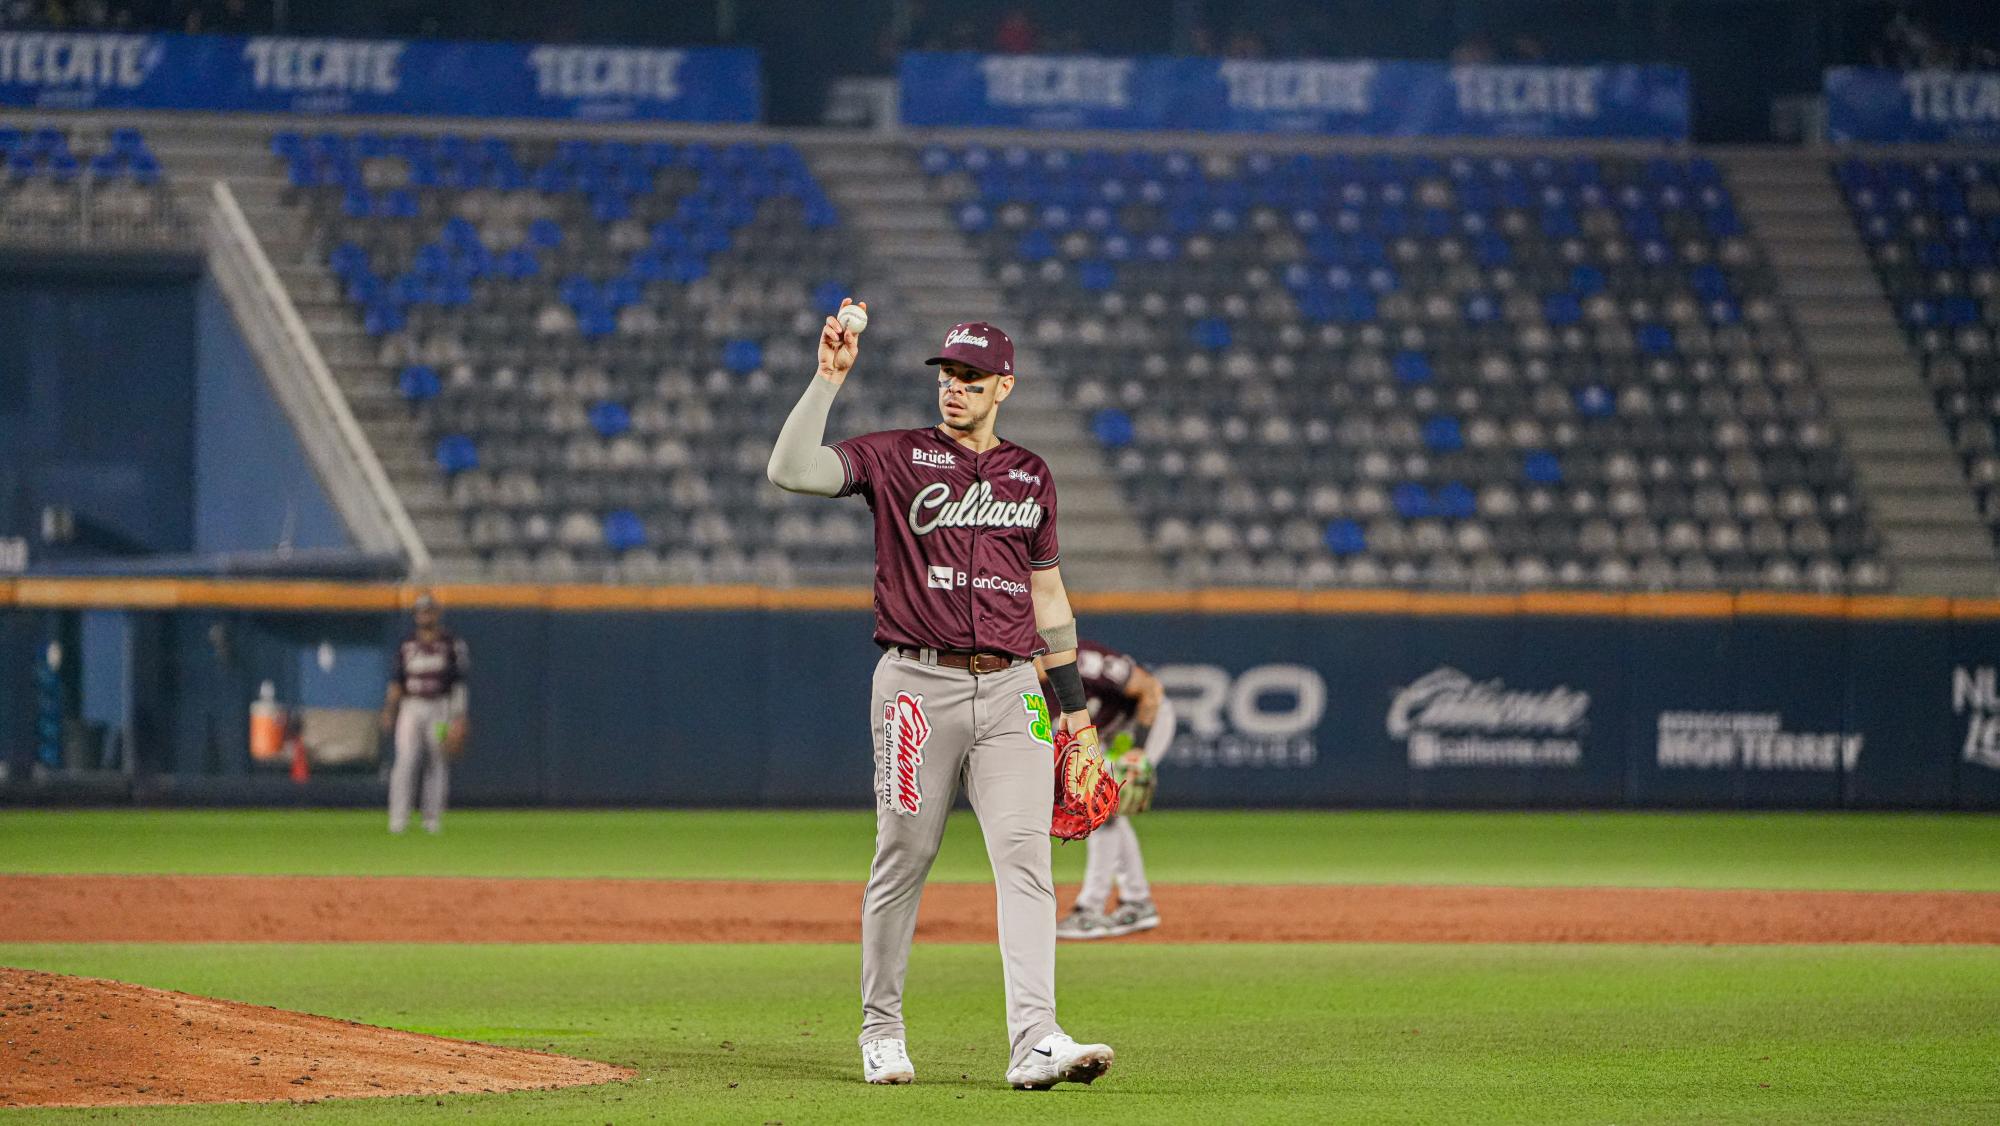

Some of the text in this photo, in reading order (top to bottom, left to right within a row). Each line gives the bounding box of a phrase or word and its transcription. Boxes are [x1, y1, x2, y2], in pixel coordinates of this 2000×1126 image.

[0, 31, 151, 87] TECATE
[244, 36, 407, 95] TECATE
[528, 46, 686, 100] TECATE
[980, 55, 1133, 108] TECATE
[1218, 58, 1378, 112] TECATE
[912, 447, 956, 465] Brück
[908, 480, 1042, 536] Culiacán
[884, 721, 893, 806] caliente.mx
[897, 693, 930, 813] Caliente
